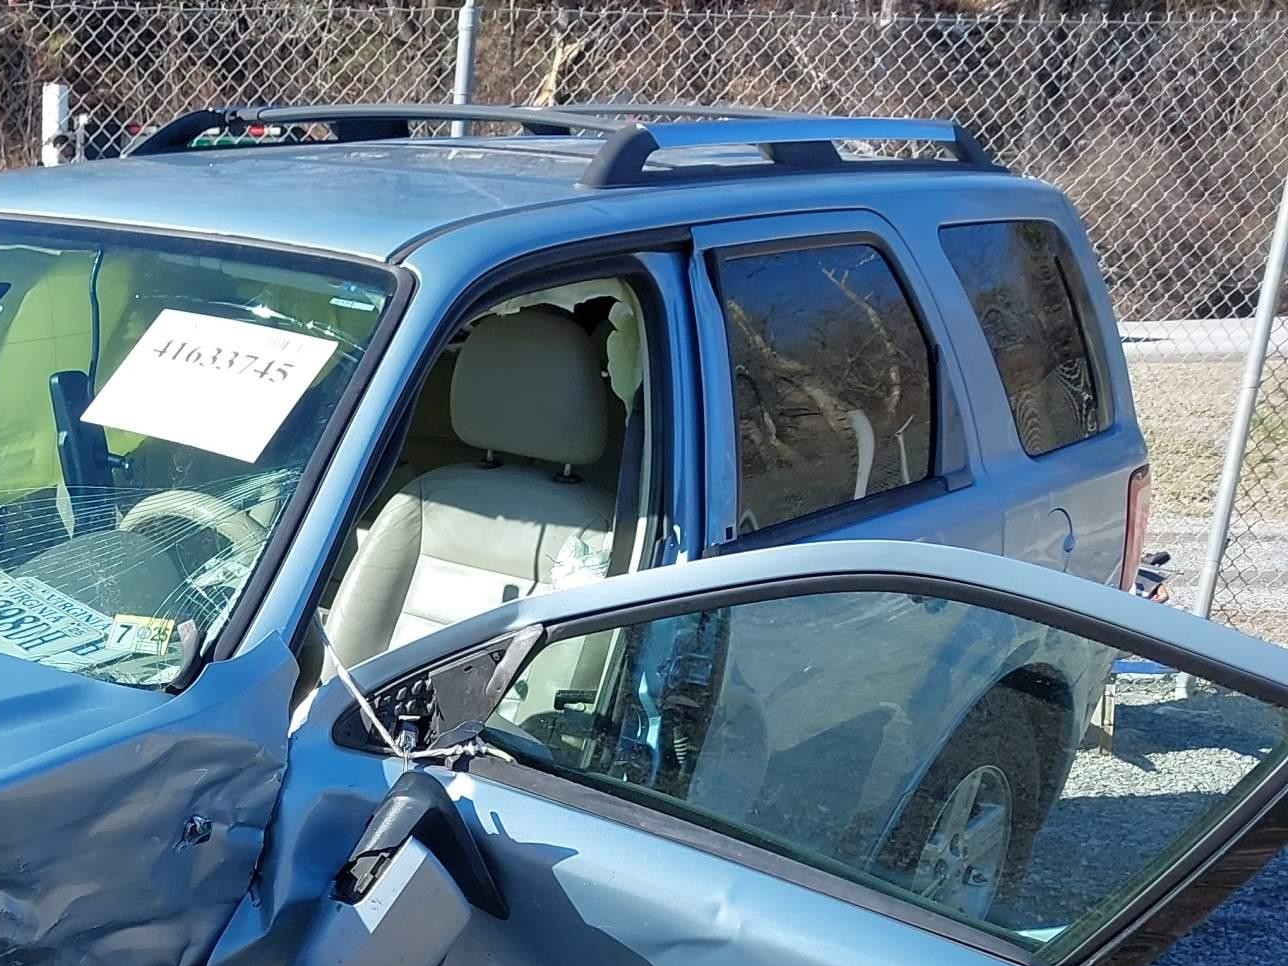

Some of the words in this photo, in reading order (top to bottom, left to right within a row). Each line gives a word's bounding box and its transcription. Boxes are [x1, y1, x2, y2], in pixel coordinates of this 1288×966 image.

[153, 340, 295, 382] 41633745
[5, 585, 64, 623] VIRGINIA
[46, 593, 111, 630] VIRGINIA
[117, 624, 133, 644] 7
